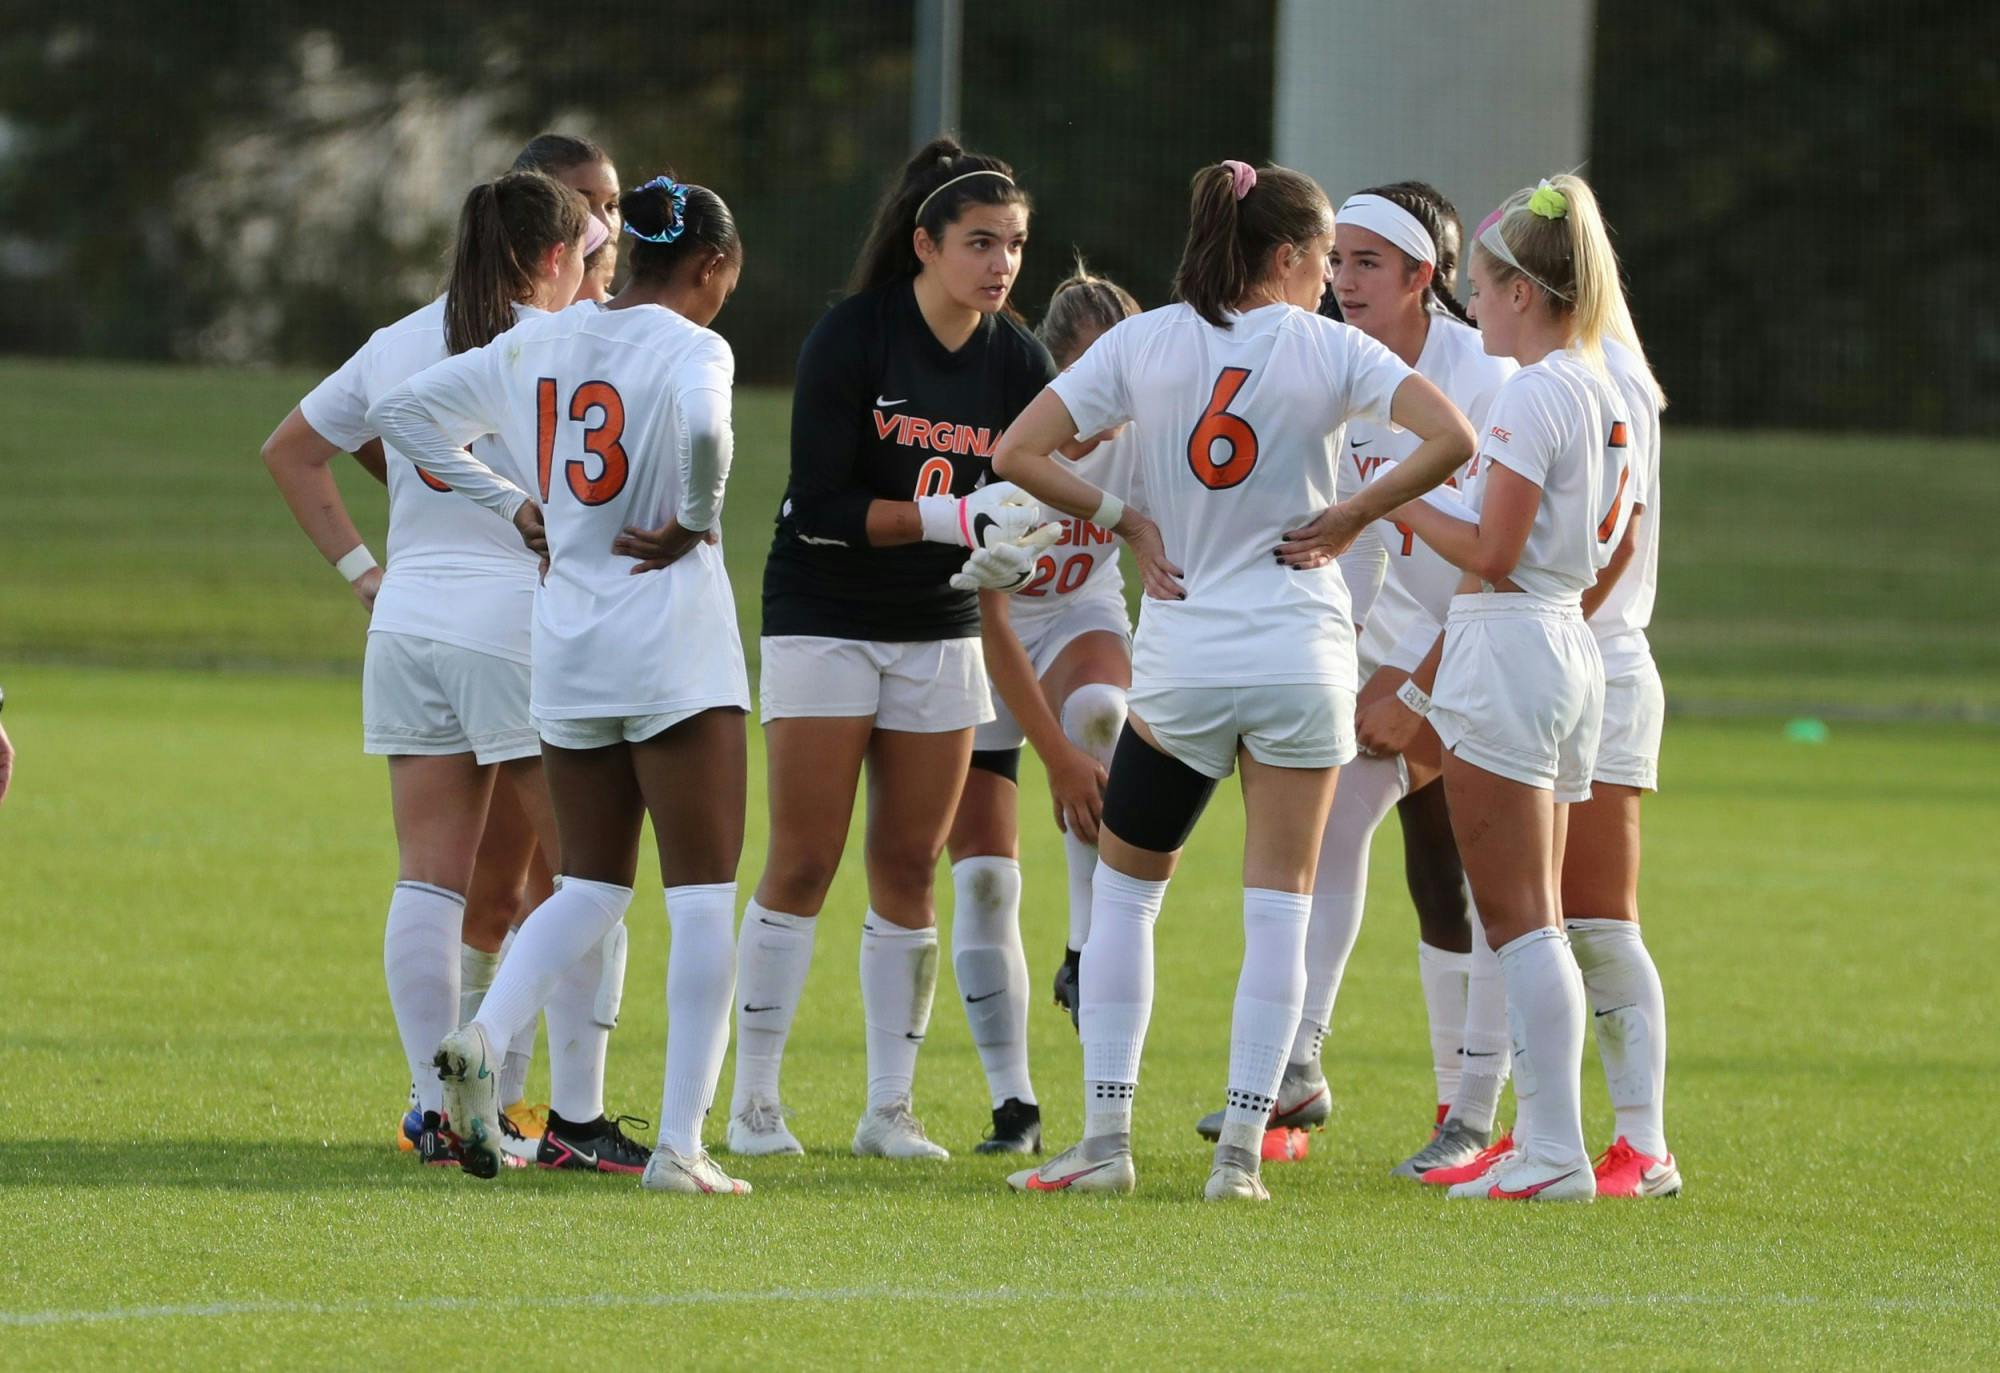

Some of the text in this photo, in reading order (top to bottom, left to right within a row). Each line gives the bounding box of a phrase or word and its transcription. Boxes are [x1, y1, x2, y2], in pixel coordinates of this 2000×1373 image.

[535, 376, 629, 506] 13
[1187, 366, 1259, 490] 6
[1016, 553, 1094, 597] 20
